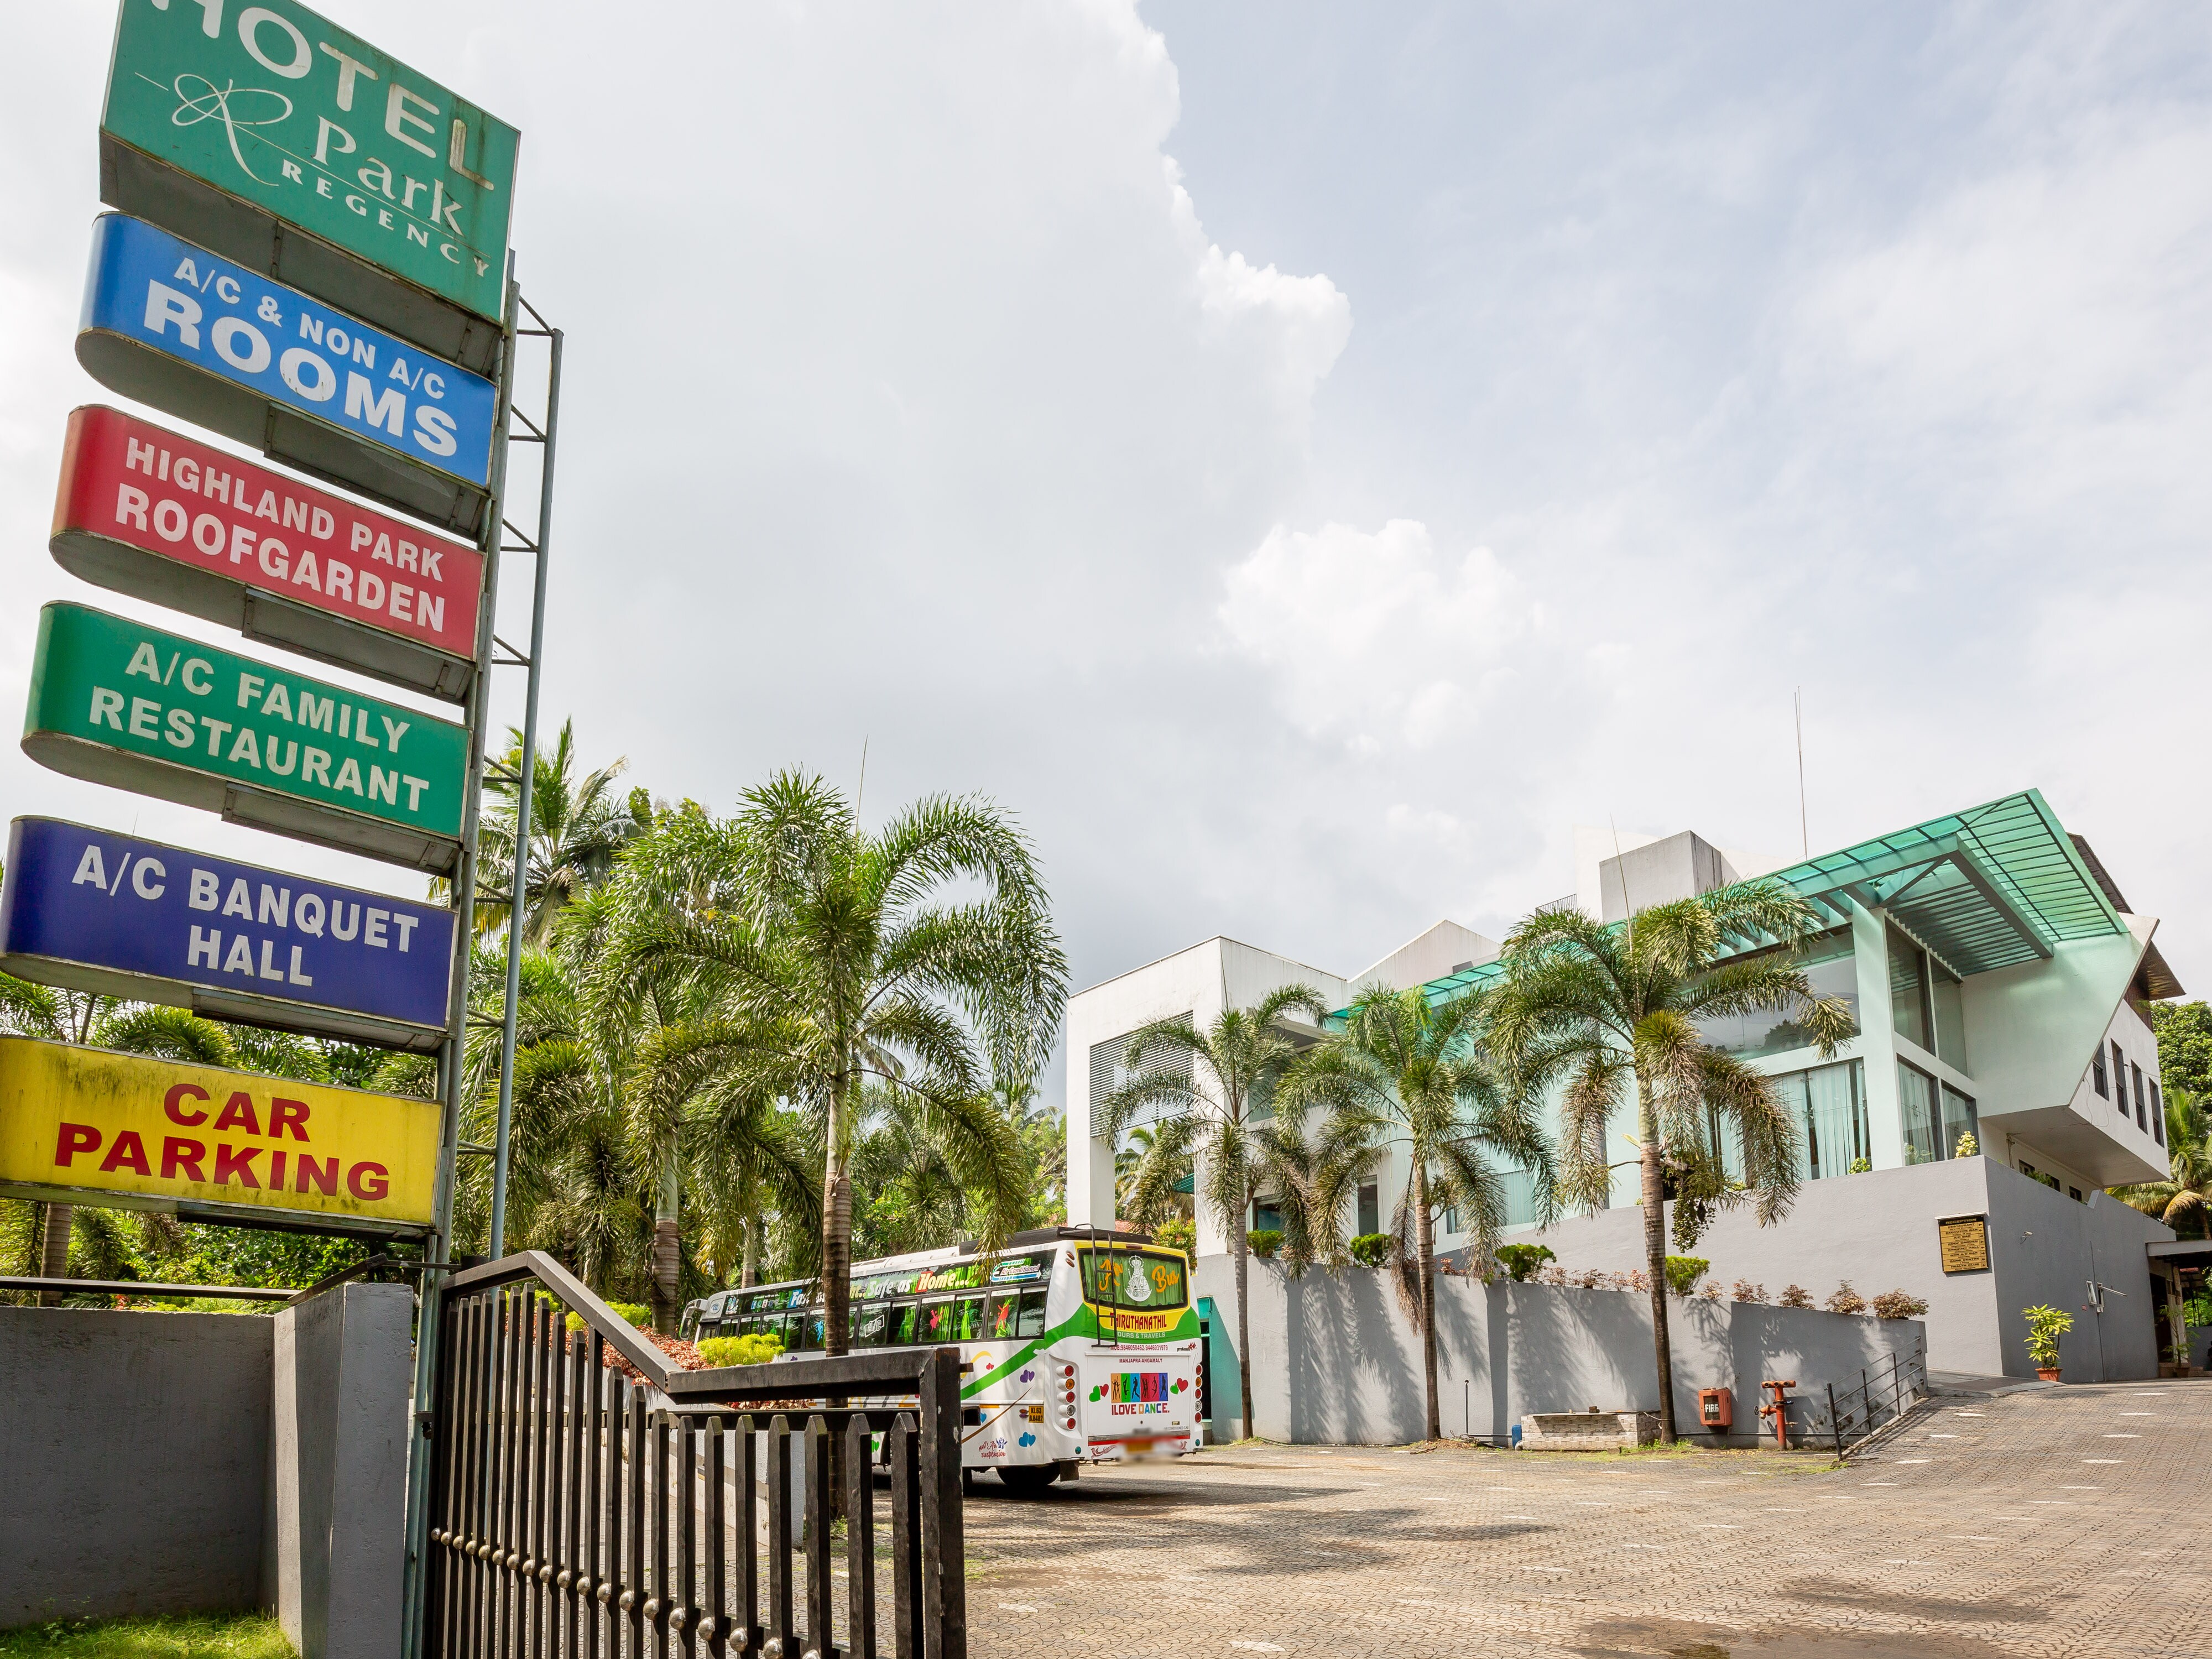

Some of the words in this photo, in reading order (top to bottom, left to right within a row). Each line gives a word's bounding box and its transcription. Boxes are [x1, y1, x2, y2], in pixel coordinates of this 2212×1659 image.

[281, 158, 489, 278] REGENCY
[311, 114, 465, 236] Park
[143, 279, 457, 456] ROOMS
[174, 258, 241, 304] A/C
[258, 295, 283, 326] &
[299, 314, 375, 368] NON
[389, 361, 446, 399] A/C
[116, 484, 444, 632] ROOFGARDEN
[126, 437, 335, 540] HIGHLAND
[351, 522, 444, 582] PARK
[89, 686, 429, 811] RESTAURANT
[125, 642, 215, 695] A/C
[238, 672, 410, 753] FAMILY
[72, 844, 166, 900] A/C
[189, 868, 419, 952] BANQUET
[187, 925, 313, 987] HALL
[55, 1123, 389, 1201] PARKING
[164, 1083, 311, 1142] CAR
[867, 1277, 894, 1298] Safe
[897, 1279, 913, 1293] as
[1009, 1264, 1041, 1274] Conditioned
[1705, 1404, 1719, 1412] FIRE
